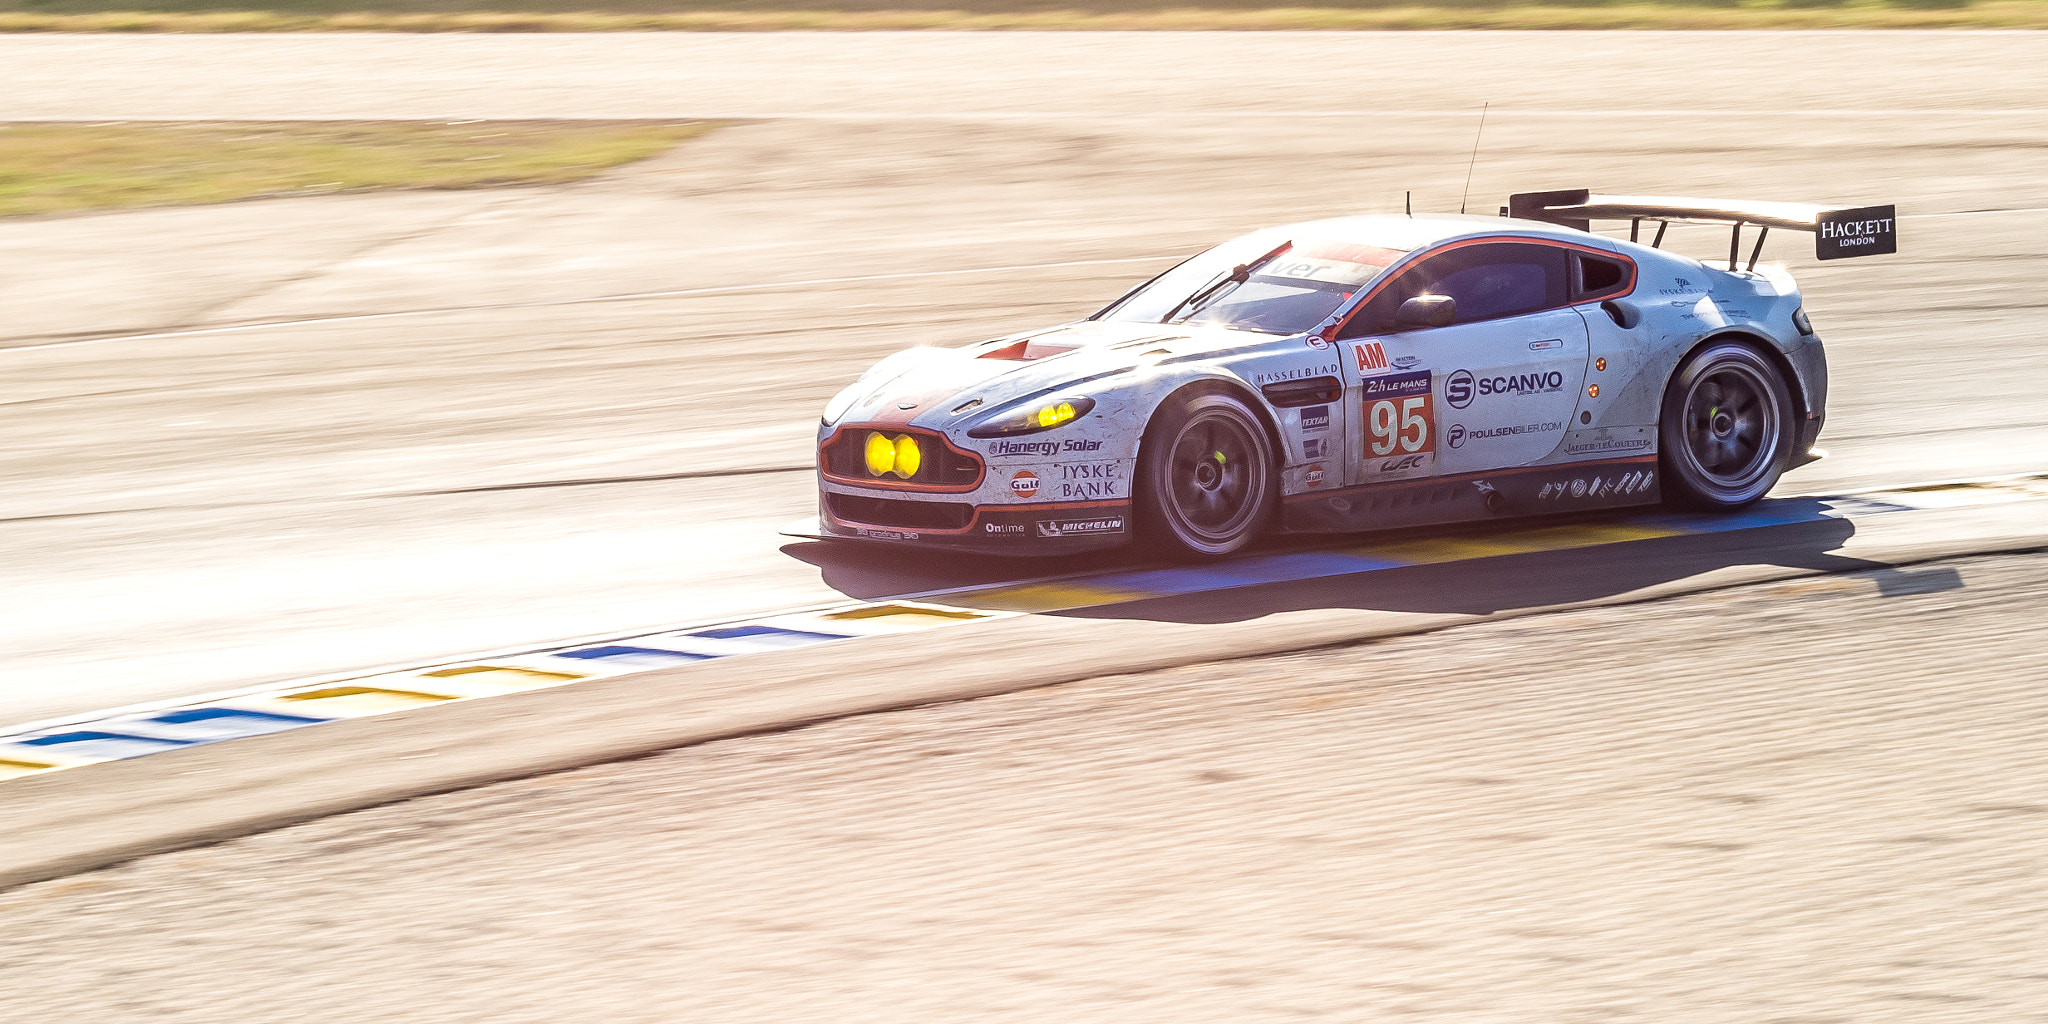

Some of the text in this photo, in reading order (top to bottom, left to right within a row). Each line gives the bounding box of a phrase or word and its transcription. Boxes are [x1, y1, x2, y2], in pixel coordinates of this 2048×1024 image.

[1821, 218, 1892, 239] HACKETT
[1839, 236, 1875, 247] LONDON
[1354, 342, 1388, 371] AM
[1257, 363, 1338, 383] HASSELBLAD
[1386, 383, 1400, 391] LE
[1400, 378, 1428, 389] MANS
[1478, 371, 1563, 396] SCANVO
[1301, 415, 1329, 428] TEXTAR
[1370, 396, 1428, 456] 95
[1469, 421, 1562, 440] POULSENBILER.COM
[998, 439, 1103, 456] Hanergy Solar
[1062, 464, 1115, 480] JYSKE
[1379, 455, 1426, 473] WEC
[1010, 477, 1041, 490] Gulf
[1062, 481, 1116, 497] BANK
[985, 522, 1025, 534] Ontime
[1062, 519, 1122, 531] MICHELIN
